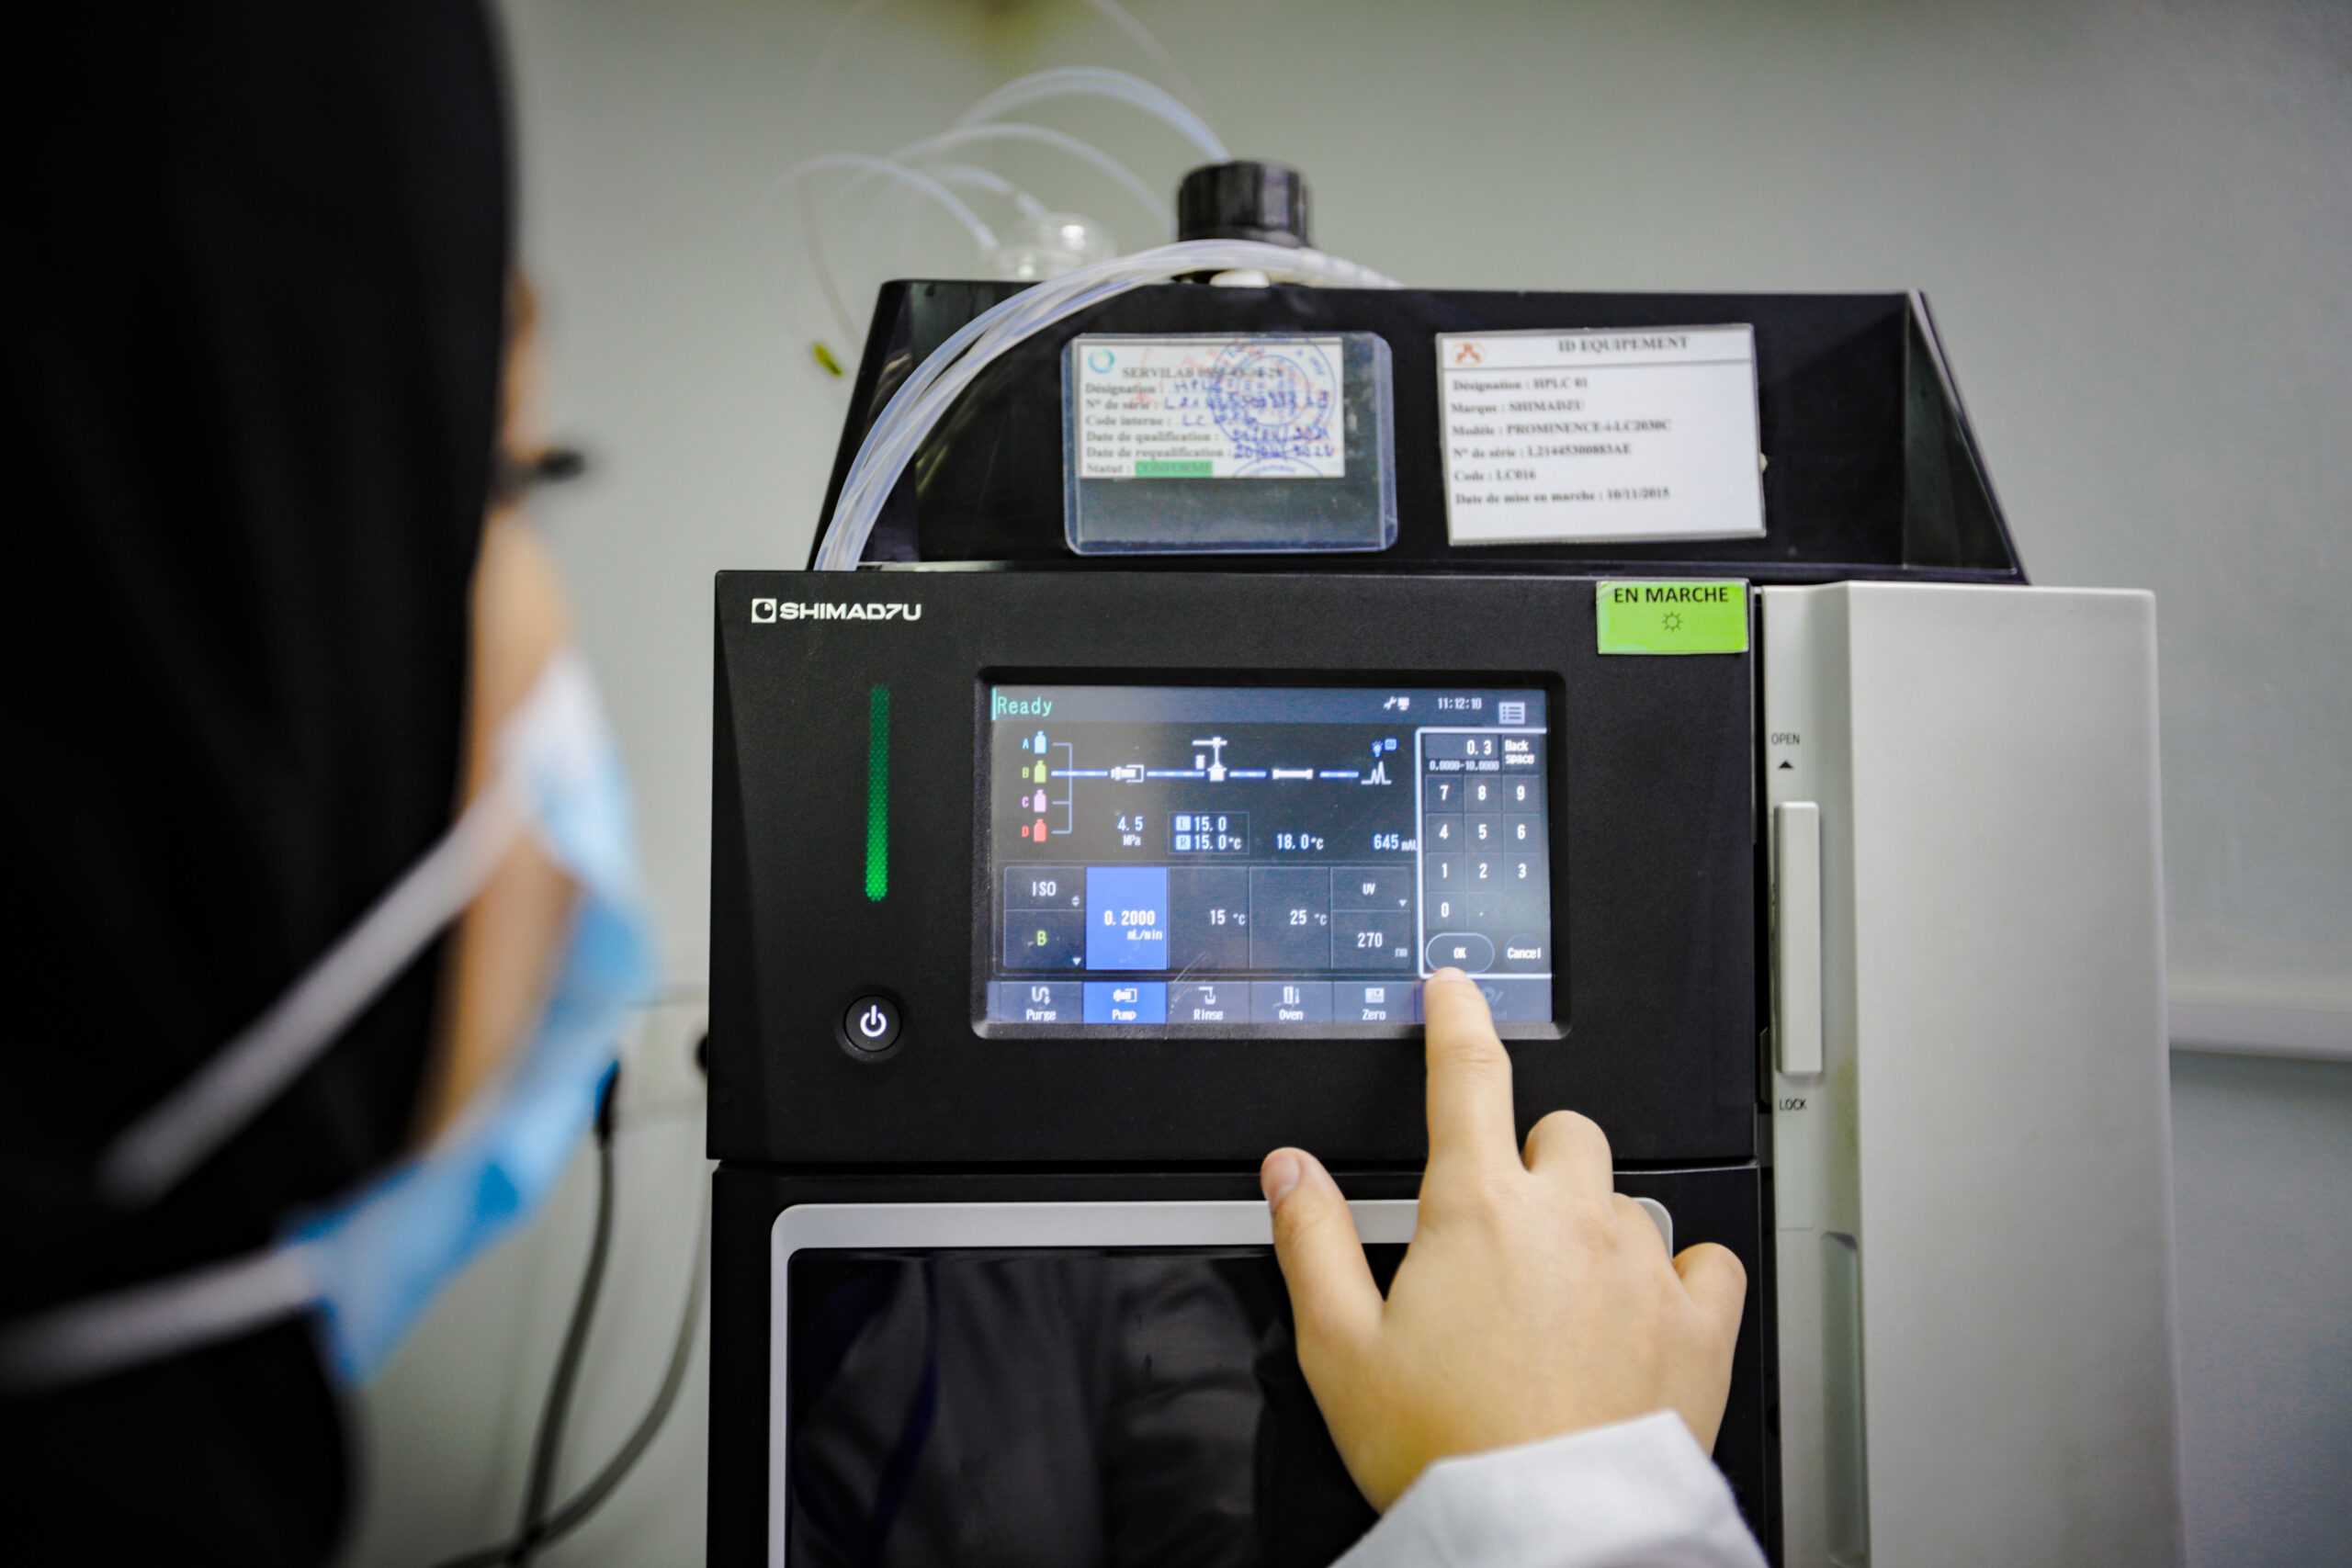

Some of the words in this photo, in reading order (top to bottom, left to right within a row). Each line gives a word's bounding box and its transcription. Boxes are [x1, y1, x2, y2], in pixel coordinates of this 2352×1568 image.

[1559, 340, 1577, 353] ID
[1580, 336, 1690, 354] EQUIPEMENT
[1453, 379, 1522, 392] Désignation
[1533, 378, 1570, 390] HPLC
[1451, 402, 1498, 416] Marque
[1509, 400, 1584, 413] SHIMADZU
[1454, 471, 1485, 482] Code
[1455, 493, 1482, 505] Date
[1487, 493, 1500, 504] de
[1504, 493, 1530, 504] mise
[1533, 494, 1549, 503] en
[1552, 490, 1595, 502] marche
[1613, 587, 1639, 604] EN
[1645, 586, 1730, 604] MARCHE
[996, 694, 1053, 717] Ready
[1436, 696, 1483, 711] 11:12:10
[1022, 738, 1030, 750] A
[1504, 739, 1530, 752] Back
[1770, 732, 1800, 746] OPEN
[1466, 739, 1493, 756] 0.3
[1504, 753, 1535, 765] space
[1022, 766, 1030, 779] B
[1439, 784, 1450, 801] 7
[1477, 784, 1487, 801] 8
[1516, 784, 1526, 801] 9
[1021, 795, 1030, 808] C
[1116, 816, 1144, 832] 4.5
[1194, 816, 1227, 832] 15.0
[1439, 824, 1450, 840] 4
[1477, 824, 1487, 840] 5
[1517, 824, 1527, 840] 6
[1122, 835, 1142, 847] MPa
[1373, 833, 1399, 851] 645
[1441, 863, 1449, 879] 1
[1479, 863, 1488, 879] 2
[1518, 863, 1528, 879] 3
[1031, 881, 1057, 897] ISO
[1362, 883, 1376, 896] UV
[1103, 909, 1156, 927] 0.2000
[1209, 908, 1227, 926] 15
[1290, 908, 1308, 926] 25
[1440, 902, 1449, 918] 0
[1035, 930, 1047, 946] B
[1356, 931, 1383, 949] 270
[1395, 947, 1408, 958] nm
[1453, 946, 1467, 960] OK
[1506, 946, 1542, 960] Cancel
[1025, 1009, 1057, 1022] Purge
[1112, 1009, 1136, 1022] Pump
[1193, 1009, 1224, 1021] Rinse
[1278, 1010, 1304, 1021] Oven
[1362, 1009, 1386, 1021] Zero
[1779, 1098, 1807, 1111] LOCK
